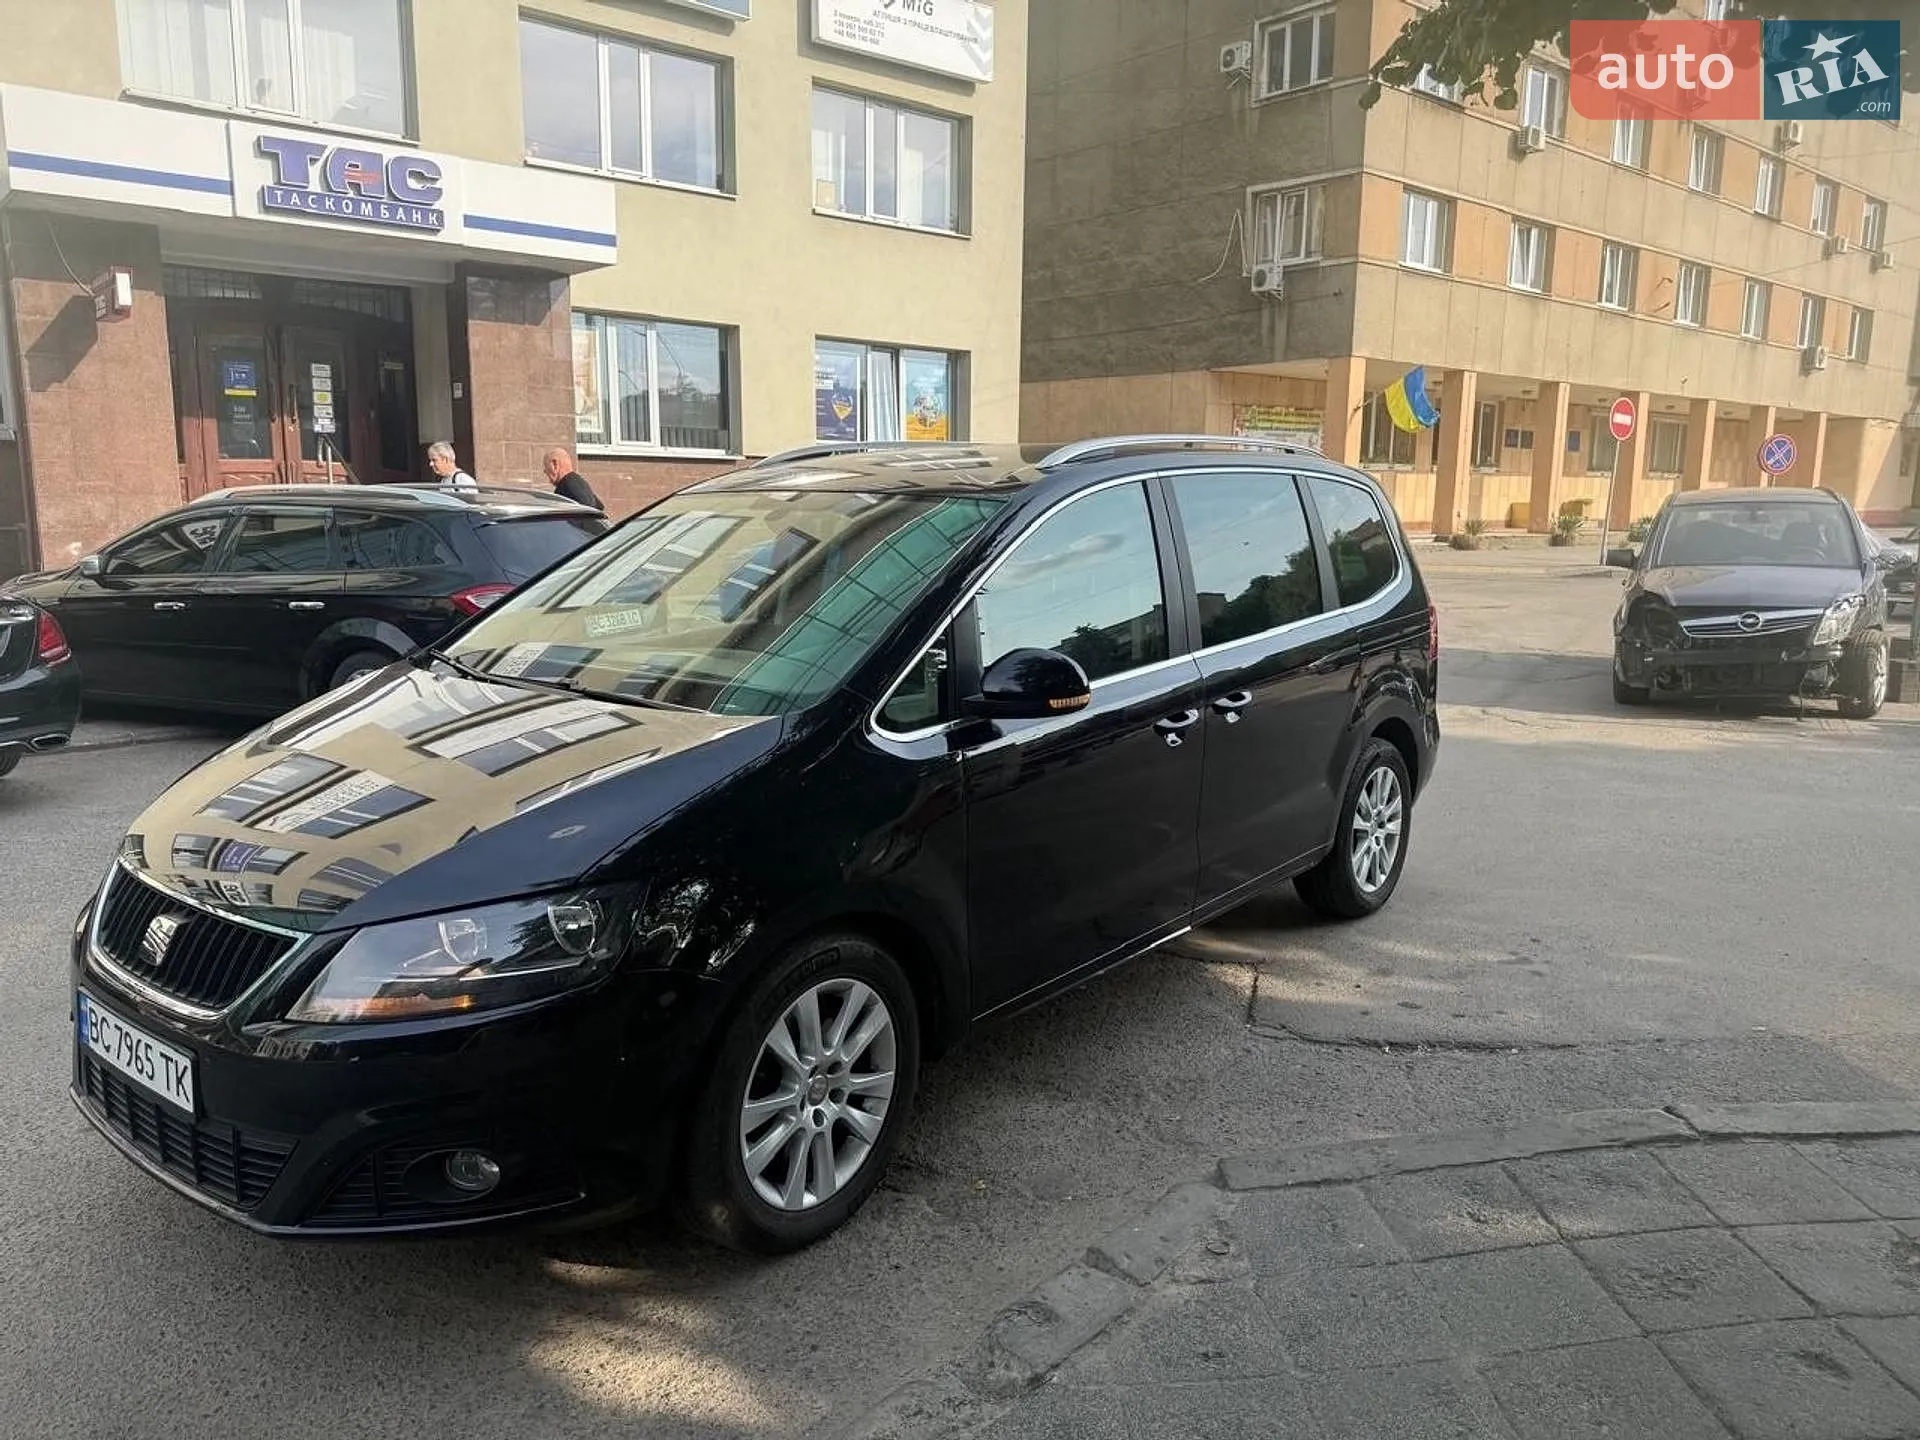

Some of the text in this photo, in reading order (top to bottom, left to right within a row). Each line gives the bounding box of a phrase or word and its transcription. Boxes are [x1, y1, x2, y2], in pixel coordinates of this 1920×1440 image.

[259, 135, 444, 204] ТАС
[274, 190, 440, 226] ТАСКОМБАНК
[88, 1006, 190, 1104] BC 7965 TK
